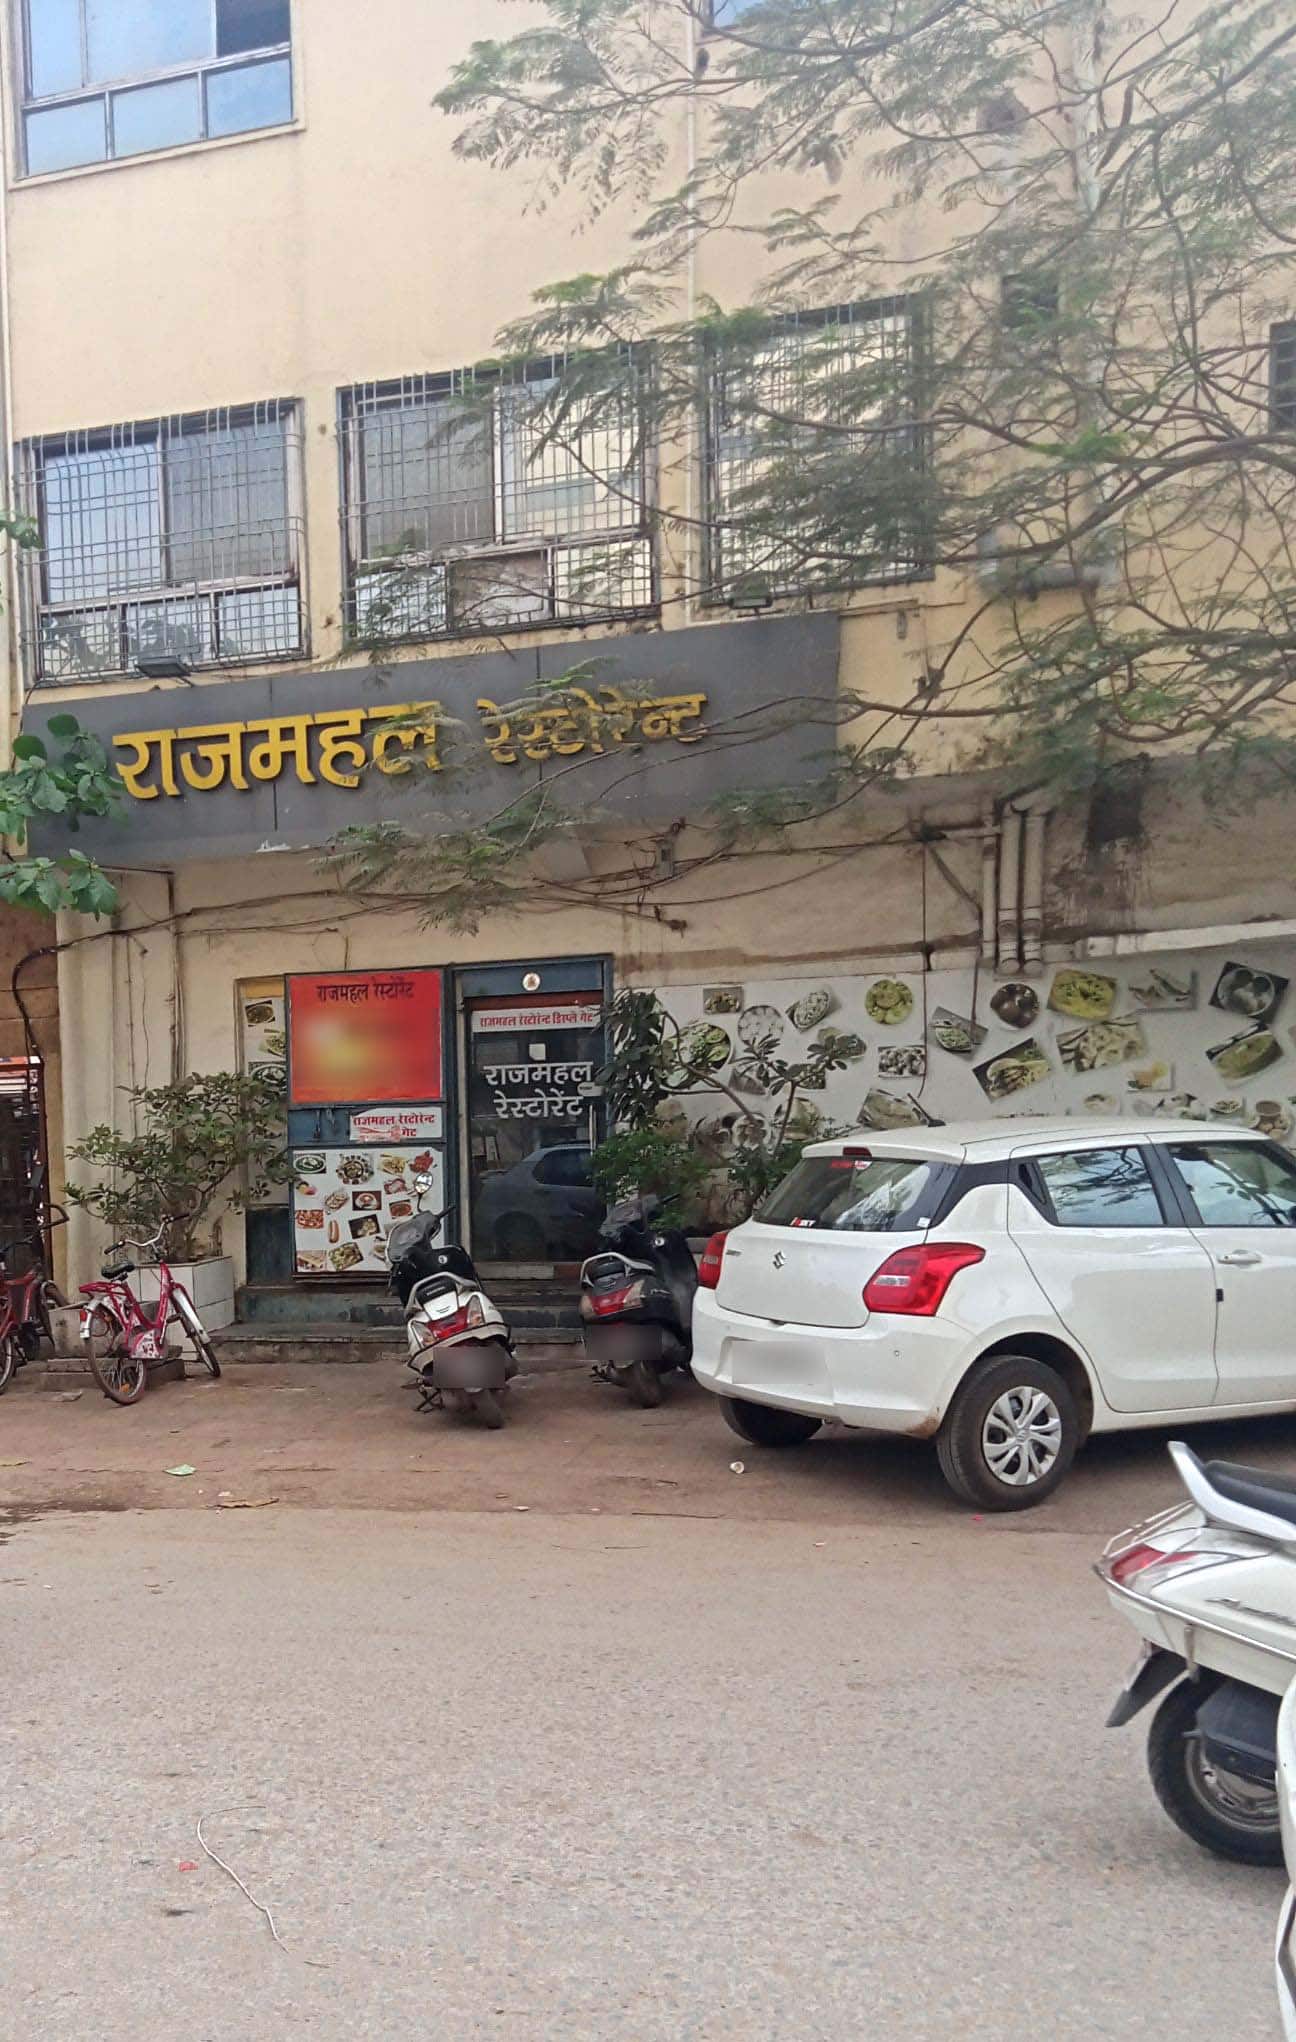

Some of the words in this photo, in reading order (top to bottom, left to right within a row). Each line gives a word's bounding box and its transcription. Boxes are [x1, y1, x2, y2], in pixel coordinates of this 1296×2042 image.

[112, 700, 441, 800] राजमहल
[316, 982, 369, 1003] राजमहल
[483, 1061, 594, 1085] राजमहल
[493, 1087, 584, 1119] रेस्टोरेंट
[353, 1115, 396, 1126] राजमहल
